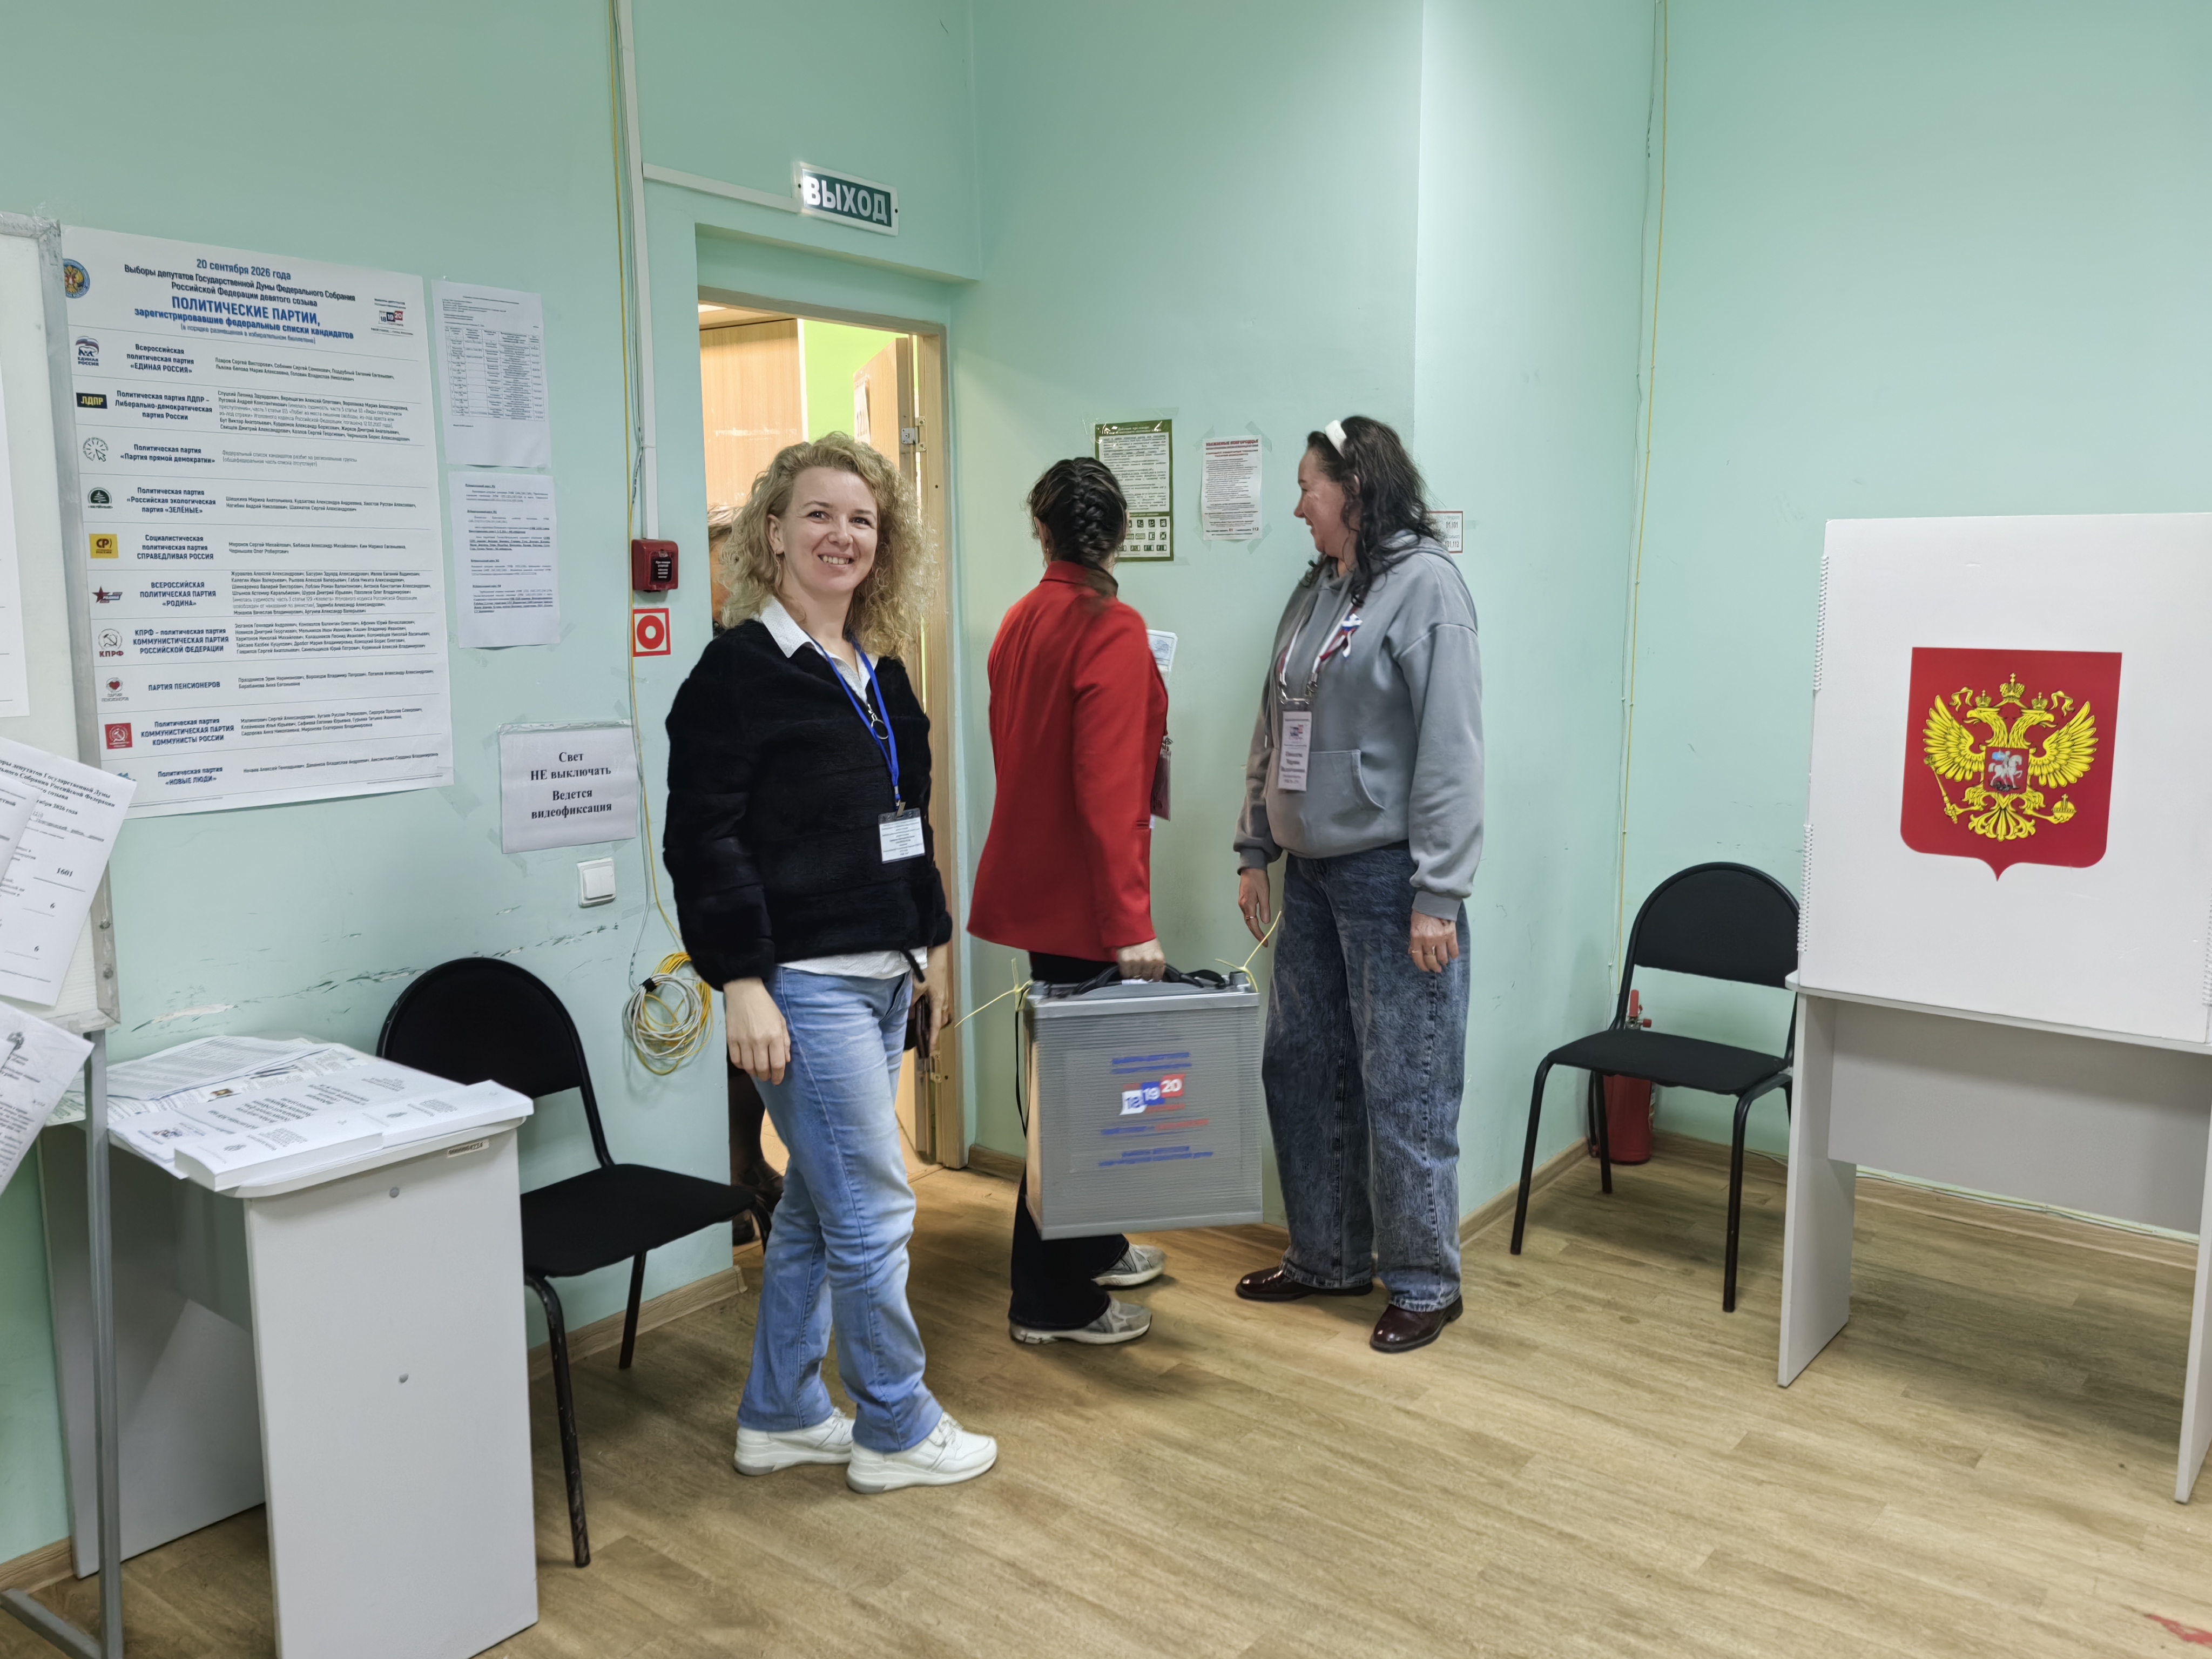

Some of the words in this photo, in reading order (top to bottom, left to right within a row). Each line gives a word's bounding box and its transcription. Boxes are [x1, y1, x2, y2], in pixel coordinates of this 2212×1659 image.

[806, 176, 887, 224] ВЫХОД
[197, 259, 207, 268] 20
[210, 262, 248, 275] сентября
[251, 266, 270, 277] 2026
[273, 271, 291, 280] года
[125, 264, 156, 276] Выборы
[158, 271, 194, 280] депутатов
[195, 274, 254, 288] Государственной
[256, 281, 274, 291] Думы
[276, 284, 323, 298] Федерального
[325, 291, 355, 301] Собрания
[172, 282, 215, 294] Российской
[218, 287, 258, 300] Федерации
[260, 294, 291, 304] девятого
[293, 298, 318, 307] созыва
[172, 296, 269, 319] ПОЛИТИЧЕСКИЕ
[272, 308, 320, 327] ПАРТИИ,
[134, 308, 224, 324] зарегистрировавшие
[226, 317, 280, 331] федеральные
[282, 325, 309, 334] списки
[311, 328, 354, 339] кандидатов
[135, 343, 184, 354] Всероссийская
[127, 353, 171, 363] политическая
[173, 357, 194, 365] партия
[130, 362, 161, 372] «ЕДИНАЯ
[163, 365, 192, 374] РОССИЯ»
[81, 396, 104, 407] ЛДПР
[117, 390, 162, 400] Политическая
[164, 394, 185, 402] партия
[115, 400, 212, 413] Либерально-демократическая
[166, 412, 188, 420] России
[134, 444, 178, 453] Политическая
[120, 453, 147, 461] «Партия
[138, 487, 181, 495] Политическая
[165, 505, 203, 514] «ЗЕЛЁНЫЕ»
[133, 637, 203, 645] КОММУНИСТИЧЕСКАЯ
[140, 645, 184, 654] РОССИЙСКОЙ
[149, 683, 173, 691] ПАРТИЯ
[174, 681, 220, 690] ПЕНСИОНЕРОВ
[154, 719, 197, 727] Политическая
[141, 729, 208, 738] КОММУНИСТИЧЕСКАЯ
[153, 737, 197, 745] КОММУНИСТЫ
[558, 751, 584, 763] Свет
[158, 768, 200, 777] Политическая
[530, 769, 548, 781] НЕ
[551, 766, 611, 779] выключать
[12, 764, 43, 777] депутатов
[43, 772, 93, 793] Государственной
[94, 789, 111, 799] Думы
[19, 772, 49, 787] Собрания
[50, 783, 84, 798] Российской
[85, 793, 116, 808] Федерации
[47, 791, 69, 800] созыва
[552, 789, 592, 801] Ведется
[53, 803, 65, 812] 2026
[65, 807, 78, 815] года
[531, 802, 612, 819] видеофиксация
[56, 867, 73, 877] 1601
[1125, 1096, 1142, 1110] 18
[1143, 1087, 1161, 1101] 19
[1161, 1078, 1183, 1093] 20
